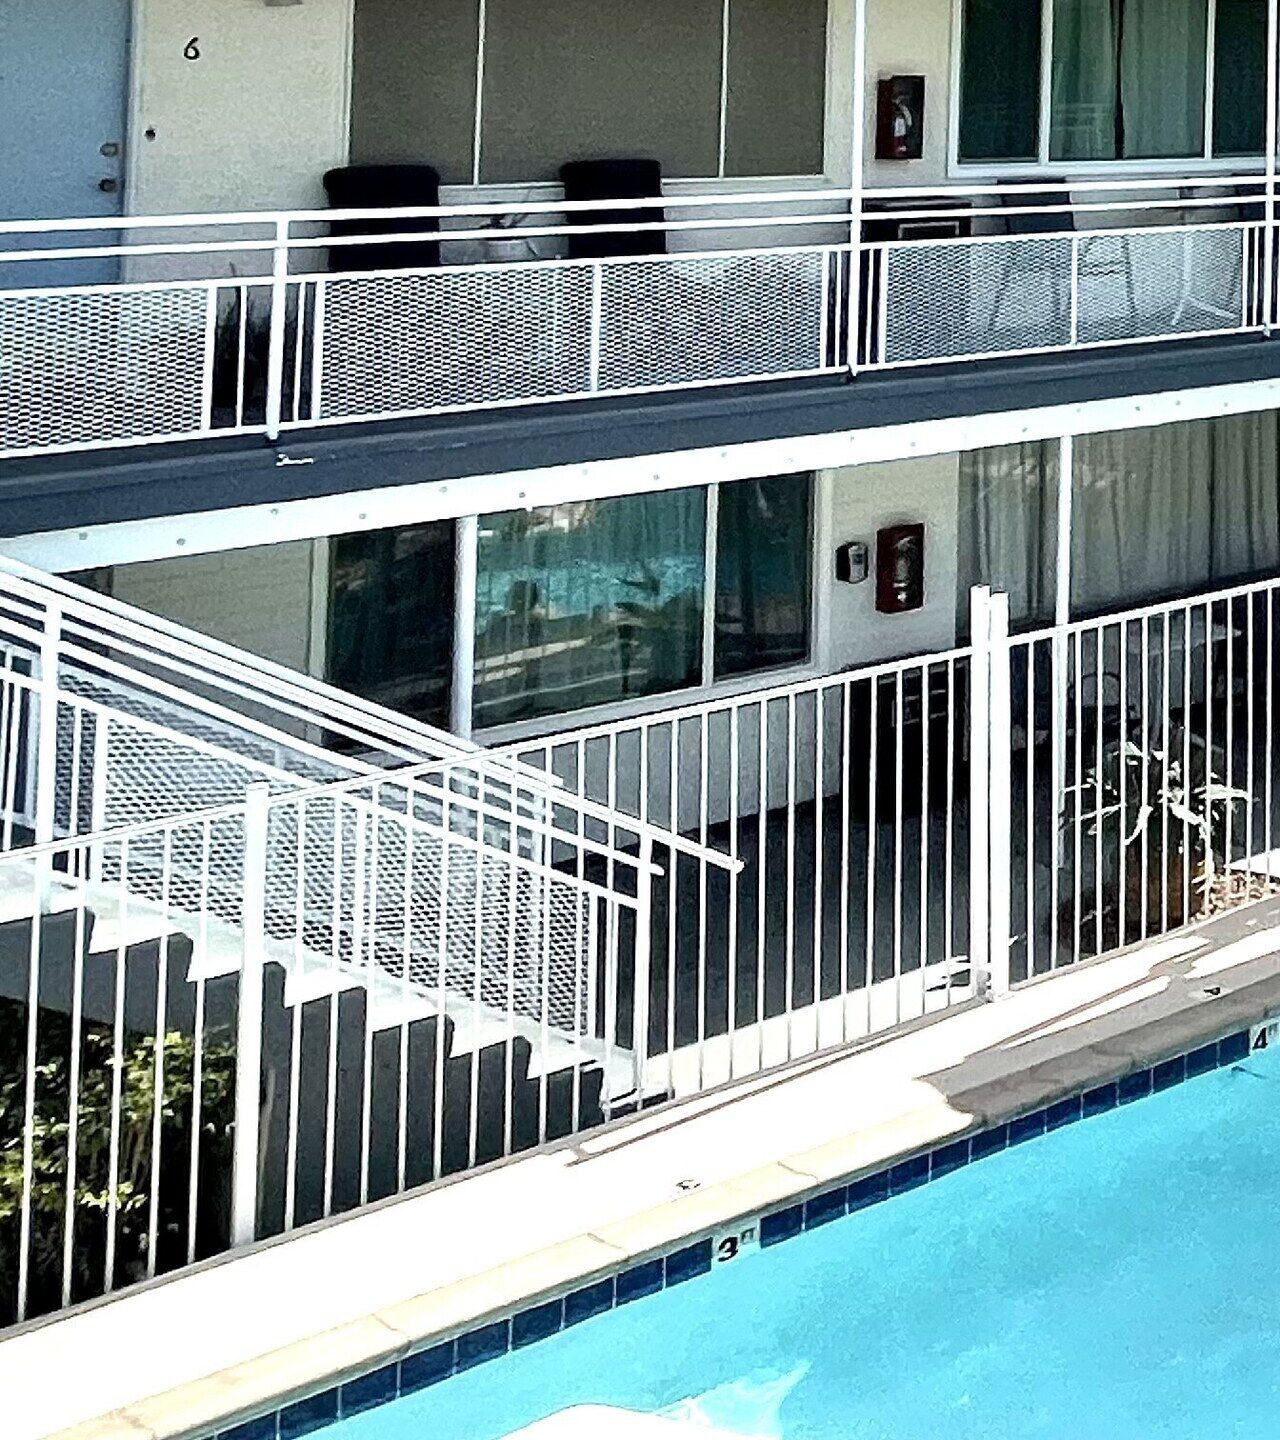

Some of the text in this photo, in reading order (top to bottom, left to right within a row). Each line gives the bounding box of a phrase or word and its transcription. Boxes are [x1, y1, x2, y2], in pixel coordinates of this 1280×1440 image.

[183, 36, 200, 60] 6
[1252, 1027, 1268, 1050] 4
[718, 1236, 738, 1262] 3
